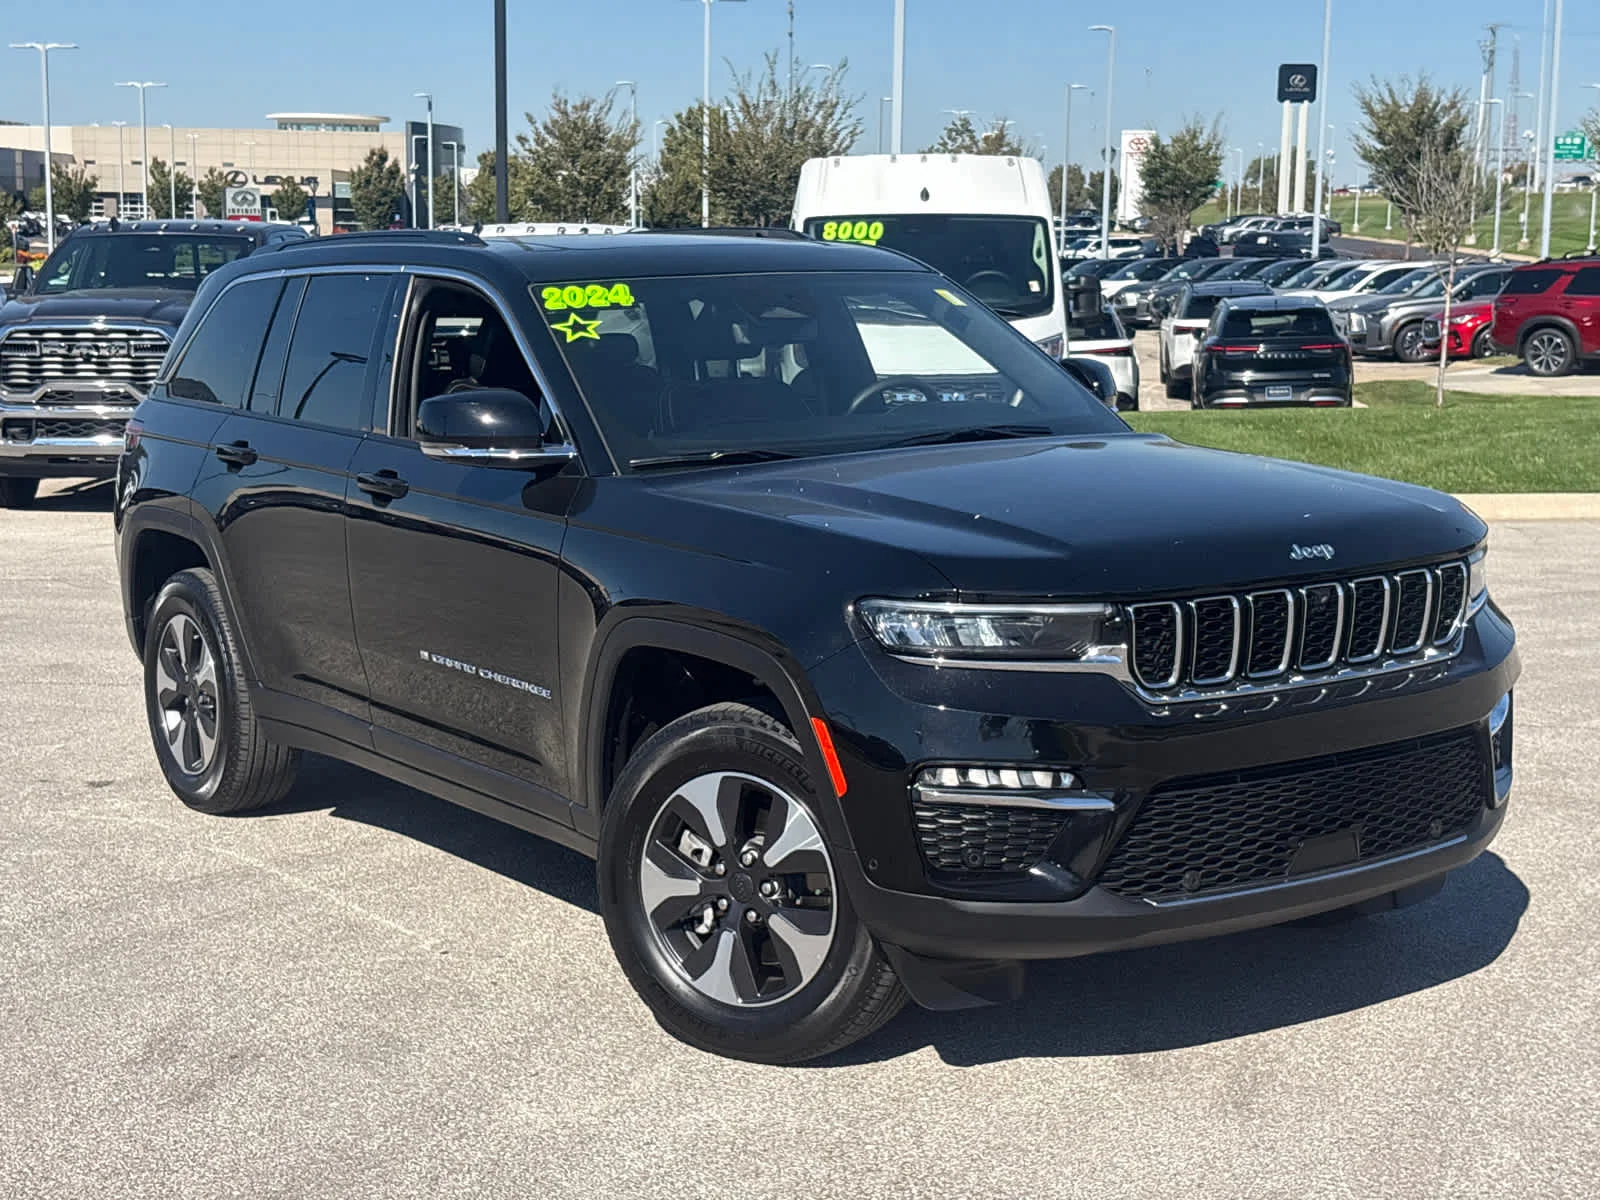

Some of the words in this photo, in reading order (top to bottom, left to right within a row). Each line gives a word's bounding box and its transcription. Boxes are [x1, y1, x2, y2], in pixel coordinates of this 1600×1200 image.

[822, 221, 884, 241] 8000
[541, 283, 635, 310] 2024
[1289, 543, 1335, 561] Jeep
[431, 653, 476, 675] GRAND
[478, 668, 552, 700] CHEROKEE
